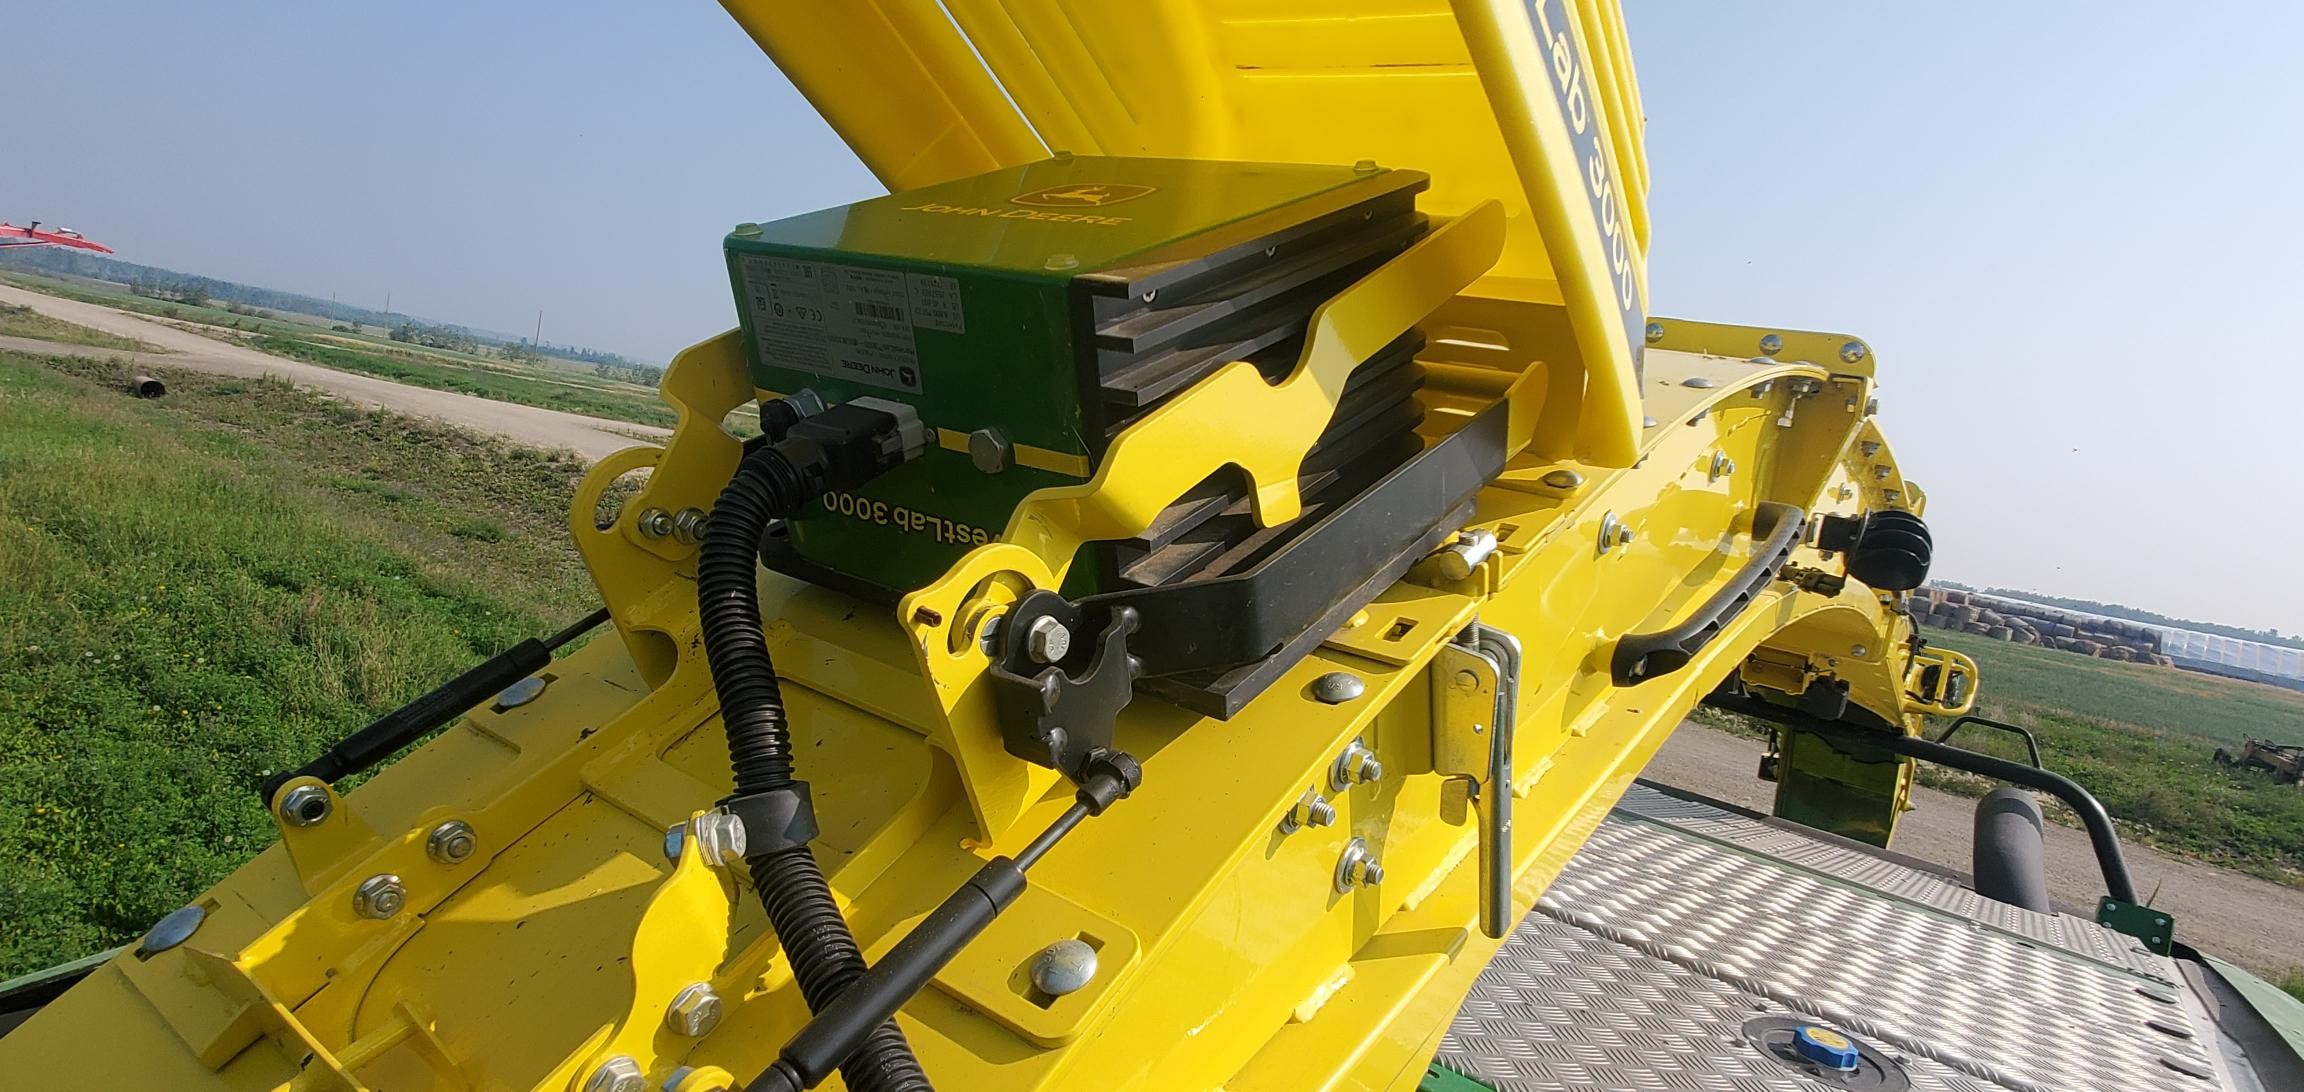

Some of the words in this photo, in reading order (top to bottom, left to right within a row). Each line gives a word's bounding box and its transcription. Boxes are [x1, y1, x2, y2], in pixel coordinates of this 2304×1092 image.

[901, 203, 1000, 217] JOHN
[1000, 209, 1133, 226] DEERE
[1589, 137, 1632, 311] 3000
[841, 359, 872, 374] DEERE
[870, 366, 896, 379] JOHN
[823, 490, 888, 525] 3000
